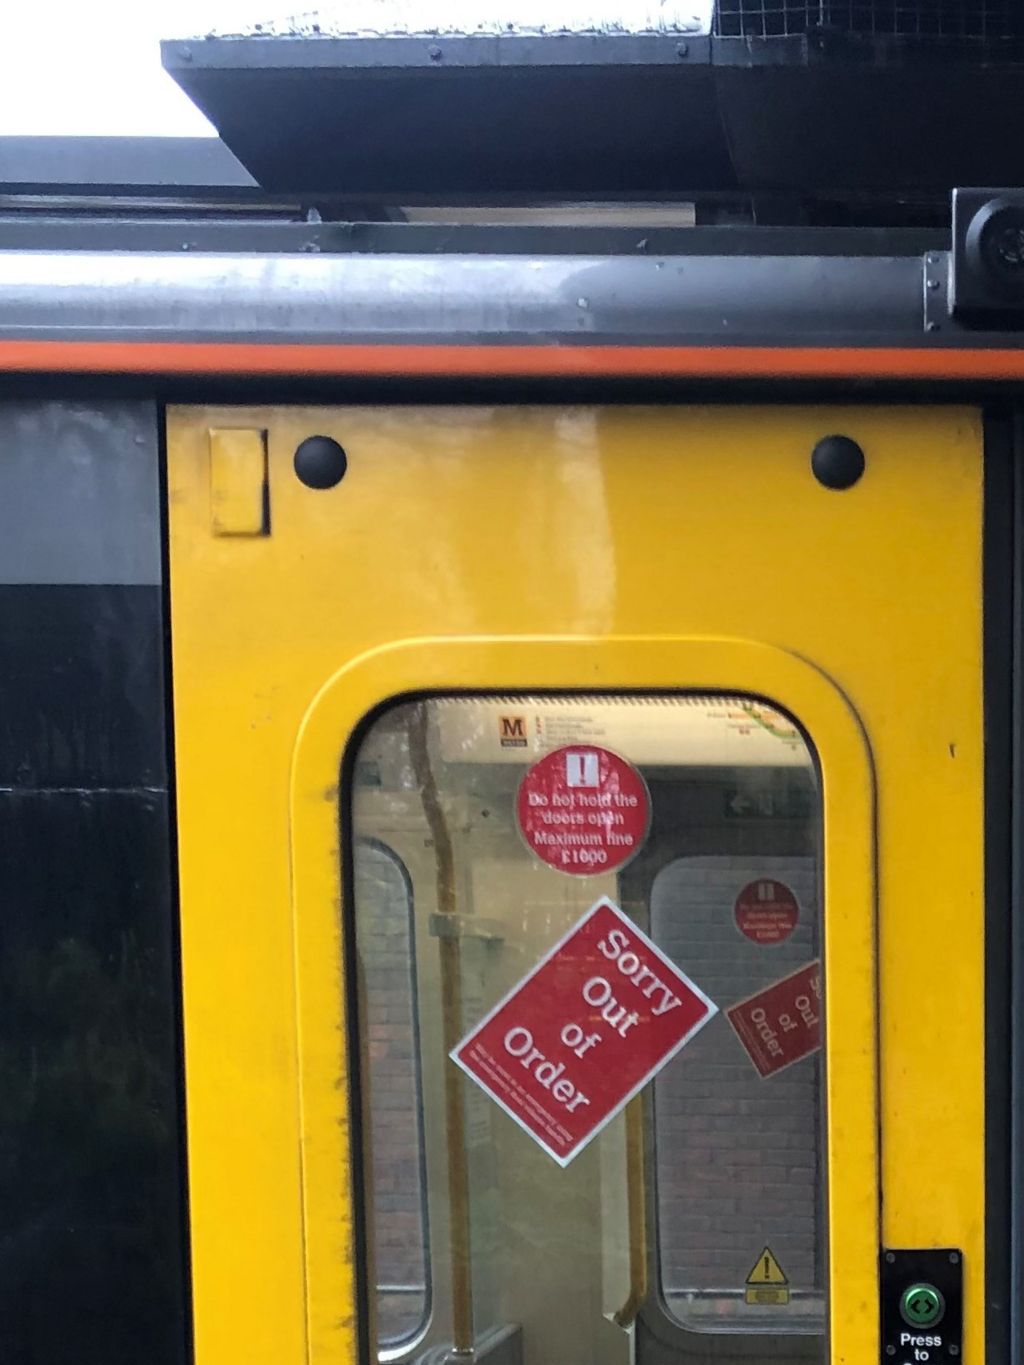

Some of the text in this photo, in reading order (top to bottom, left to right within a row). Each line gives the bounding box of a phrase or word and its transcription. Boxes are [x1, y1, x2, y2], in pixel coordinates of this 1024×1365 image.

[502, 718, 524, 736] M
[529, 792, 637, 807] Do not hold the
[544, 812, 584, 825] doors
[535, 831, 632, 845] Maximum fine
[597, 929, 682, 1016] Sorry
[582, 976, 639, 1038] Out
[561, 1023, 602, 1059] of
[751, 1008, 784, 1057] Order
[503, 1026, 590, 1113] Order
[901, 1333, 942, 1347] Press
[914, 1348, 929, 1361] to
